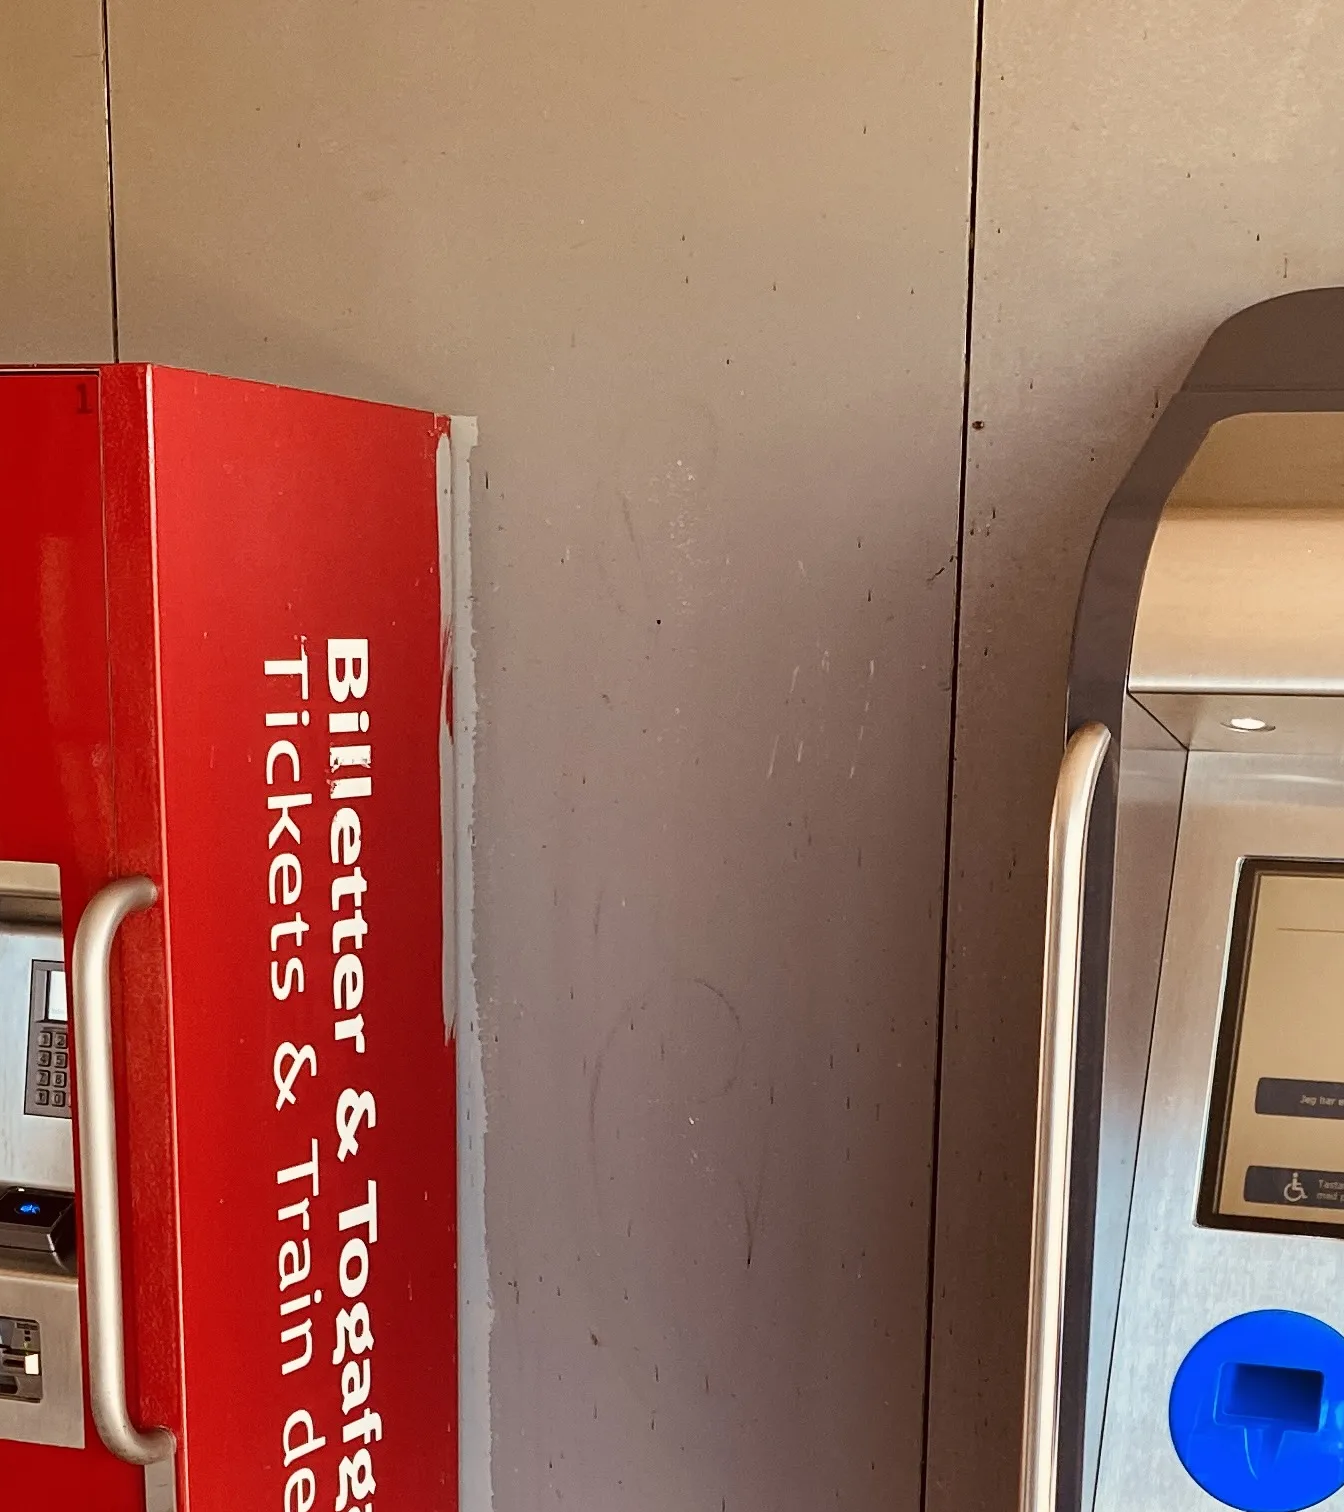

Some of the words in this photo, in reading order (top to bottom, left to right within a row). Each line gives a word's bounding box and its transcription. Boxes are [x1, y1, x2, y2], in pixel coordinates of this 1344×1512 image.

[263, 644, 313, 1001] Tickets
[327, 638, 372, 1054] Billetter
[273, 1041, 318, 1111] &
[335, 1088, 376, 1162] &
[276, 1137, 323, 1376] Train
